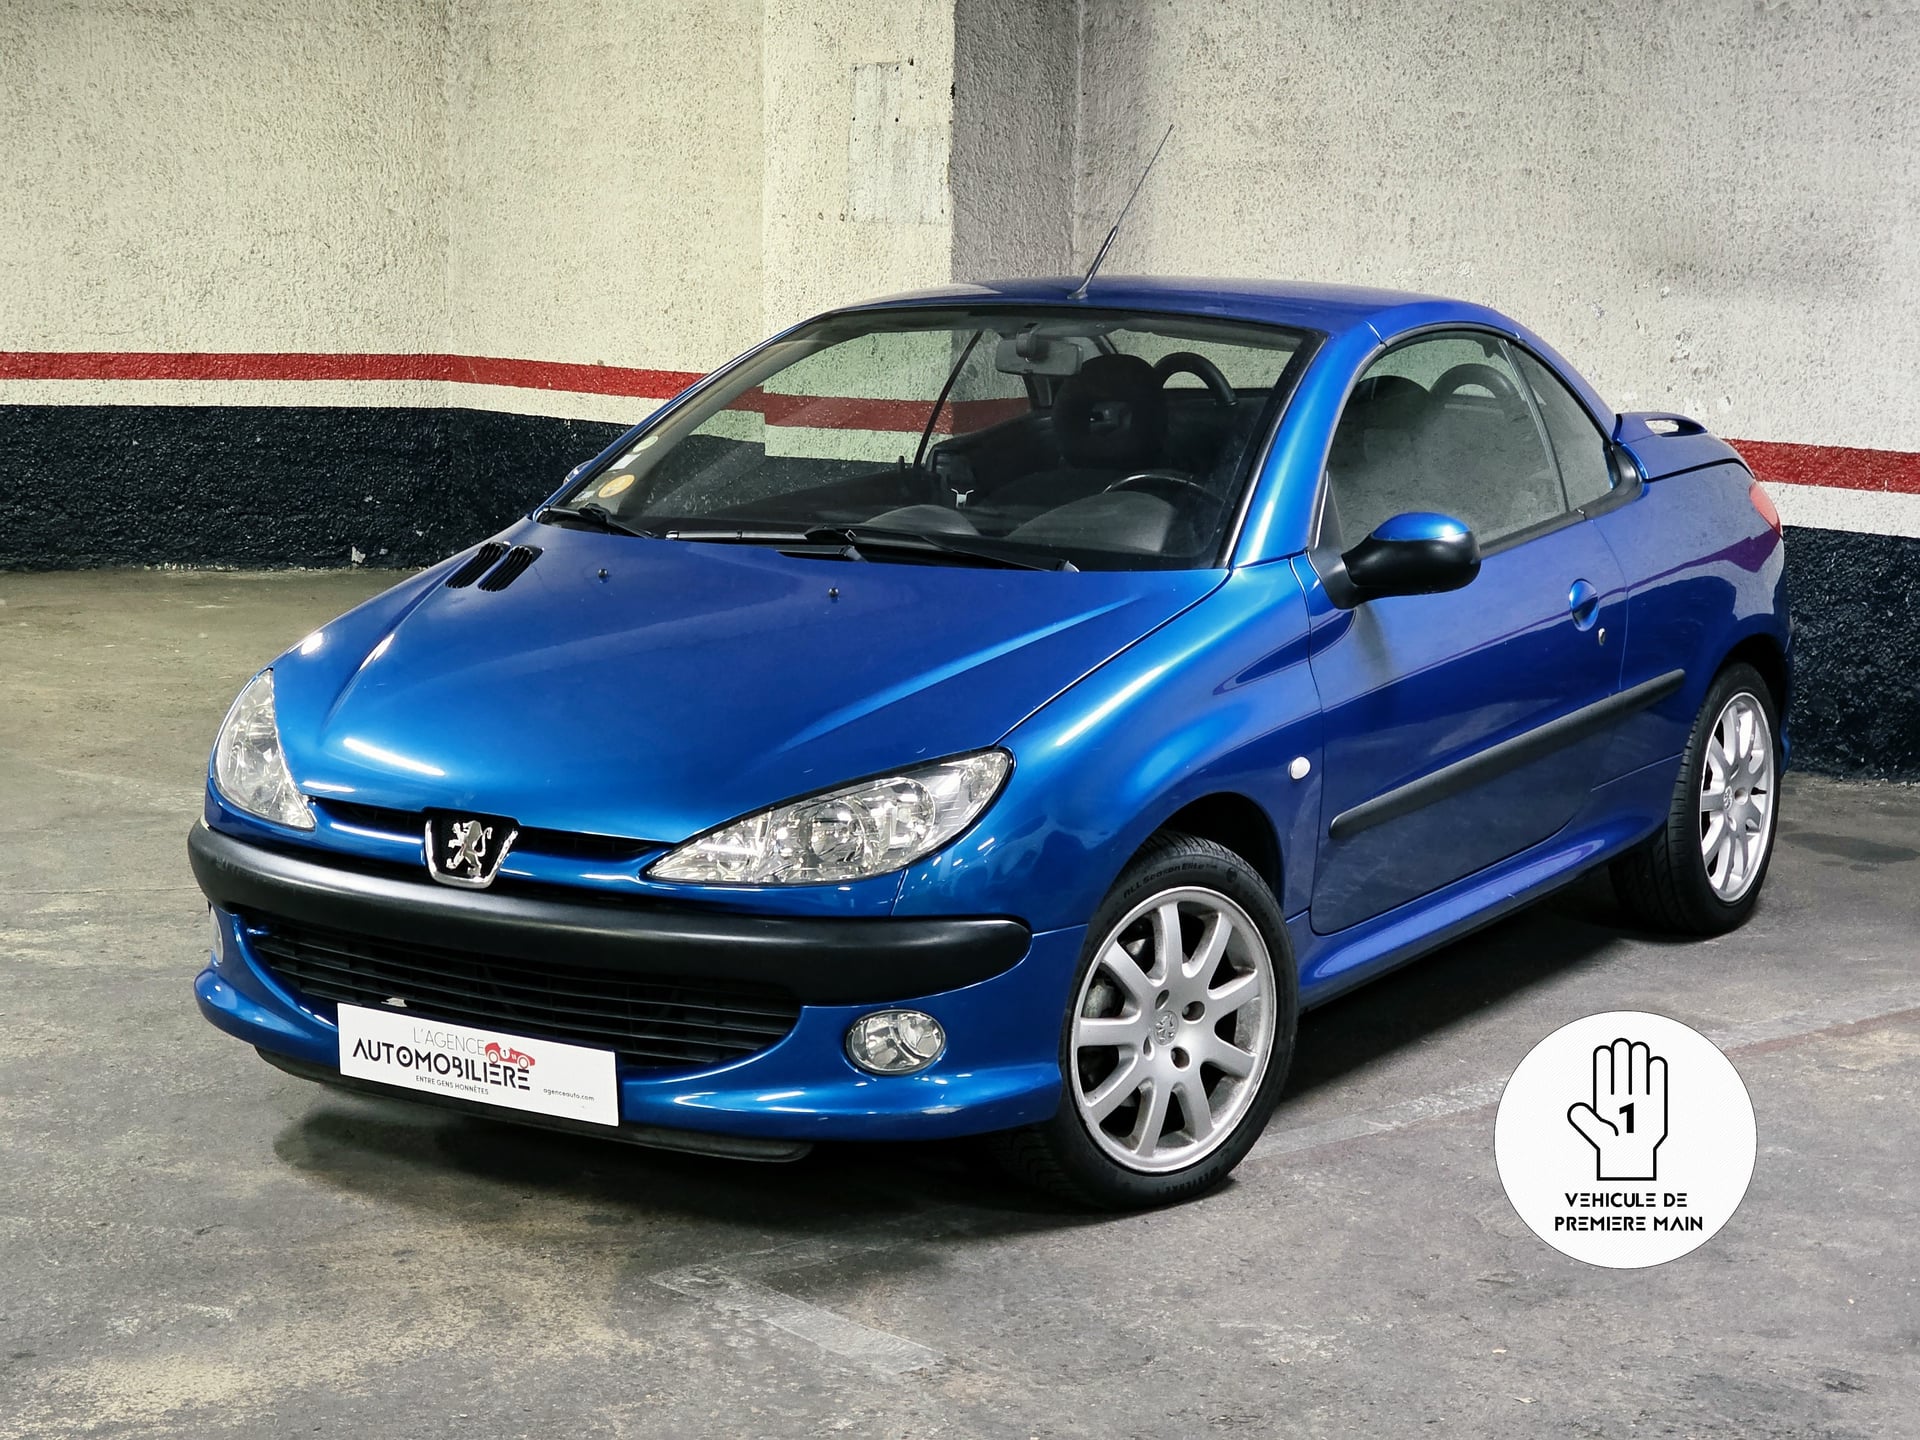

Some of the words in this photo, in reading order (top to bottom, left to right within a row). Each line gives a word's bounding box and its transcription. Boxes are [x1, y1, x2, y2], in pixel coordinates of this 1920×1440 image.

[413, 1027, 485, 1056] L'AGENCE
[416, 1075, 435, 1085] ENTRE
[436, 1079, 454, 1089] GENS
[455, 1083, 489, 1095] HONNÊTES
[543, 1088, 595, 1102] agenceauto.com
